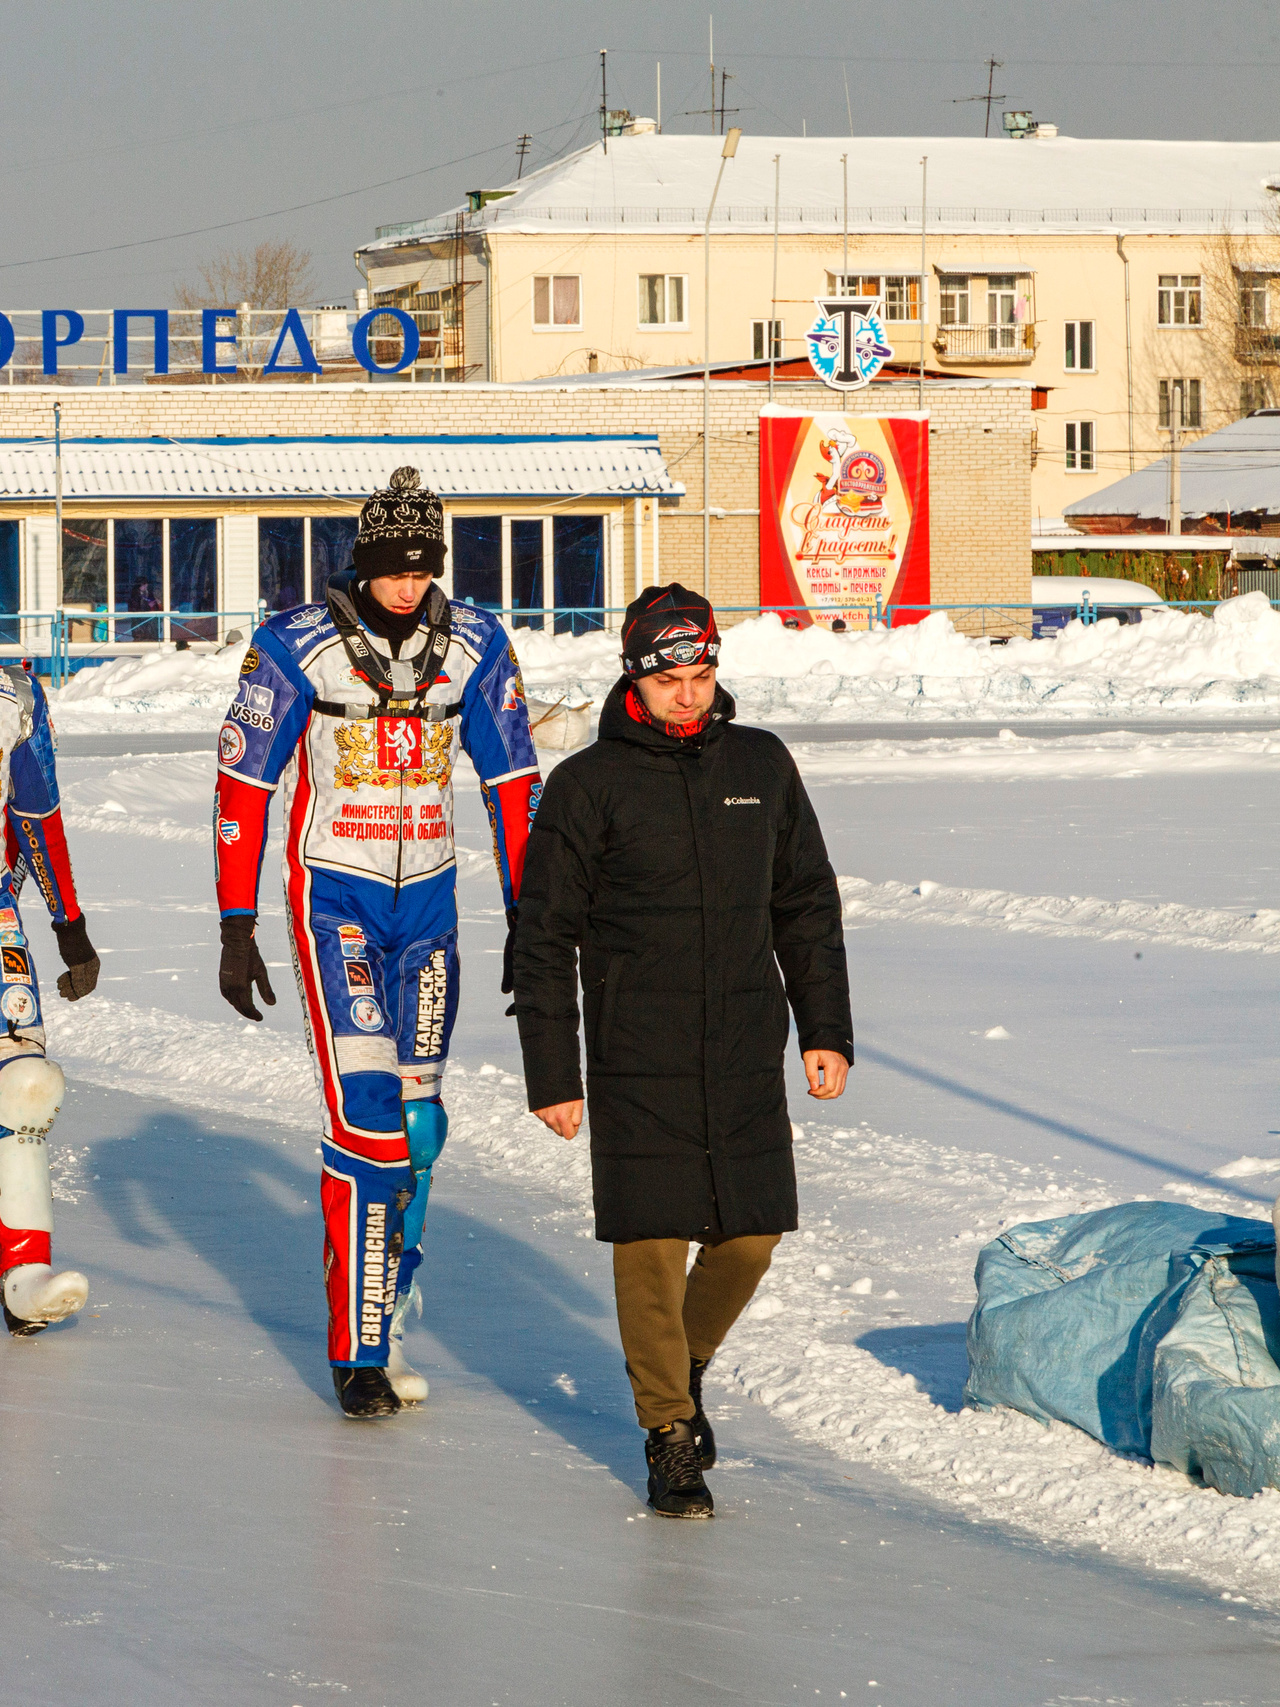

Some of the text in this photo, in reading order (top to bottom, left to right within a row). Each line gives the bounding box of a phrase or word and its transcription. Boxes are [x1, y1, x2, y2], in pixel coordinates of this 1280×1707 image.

[791, 503, 892, 538] Сладость
[815, 534, 896, 562] радость!
[807, 567, 886, 580] кексы пирожные
[811, 583, 882, 594] торты печенье
[640, 653, 659, 670] ICE
[731, 797, 761, 805] Columbia
[341, 803, 413, 820] МИНИСТЕРСТВО
[332, 821, 414, 842] СВЕРДЛОВСКОЙ
[3, 956, 23, 973] ТМК
[349, 972, 367, 985] ТМК
[414, 965, 434, 1058] КАМЕНСК-
[429, 949, 447, 1057] УРАЛЬСКИЙ
[360, 1202, 387, 1347] СВЕРДЛОВСКАЯ
